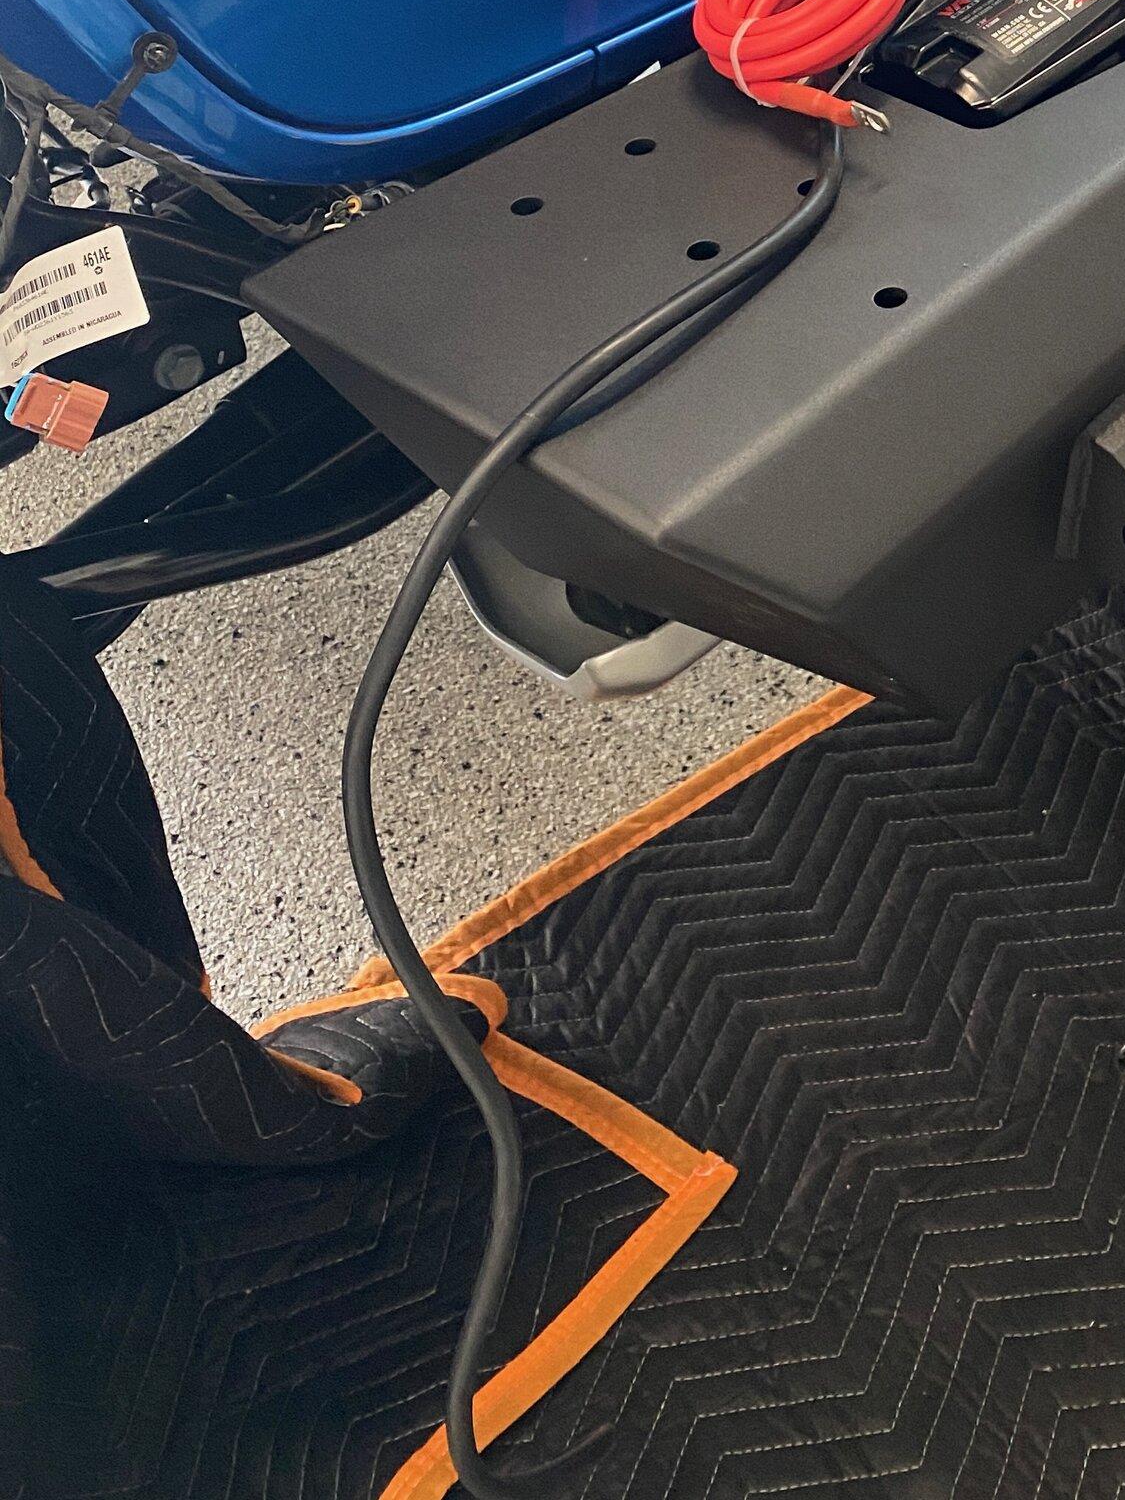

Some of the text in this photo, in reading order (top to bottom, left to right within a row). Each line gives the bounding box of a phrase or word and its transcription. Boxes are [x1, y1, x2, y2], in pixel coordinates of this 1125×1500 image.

[82, 246, 112, 269] 461AE
[42, 327, 77, 346] ASSEMBLED
[86, 310, 123, 328] NICARAGUA
